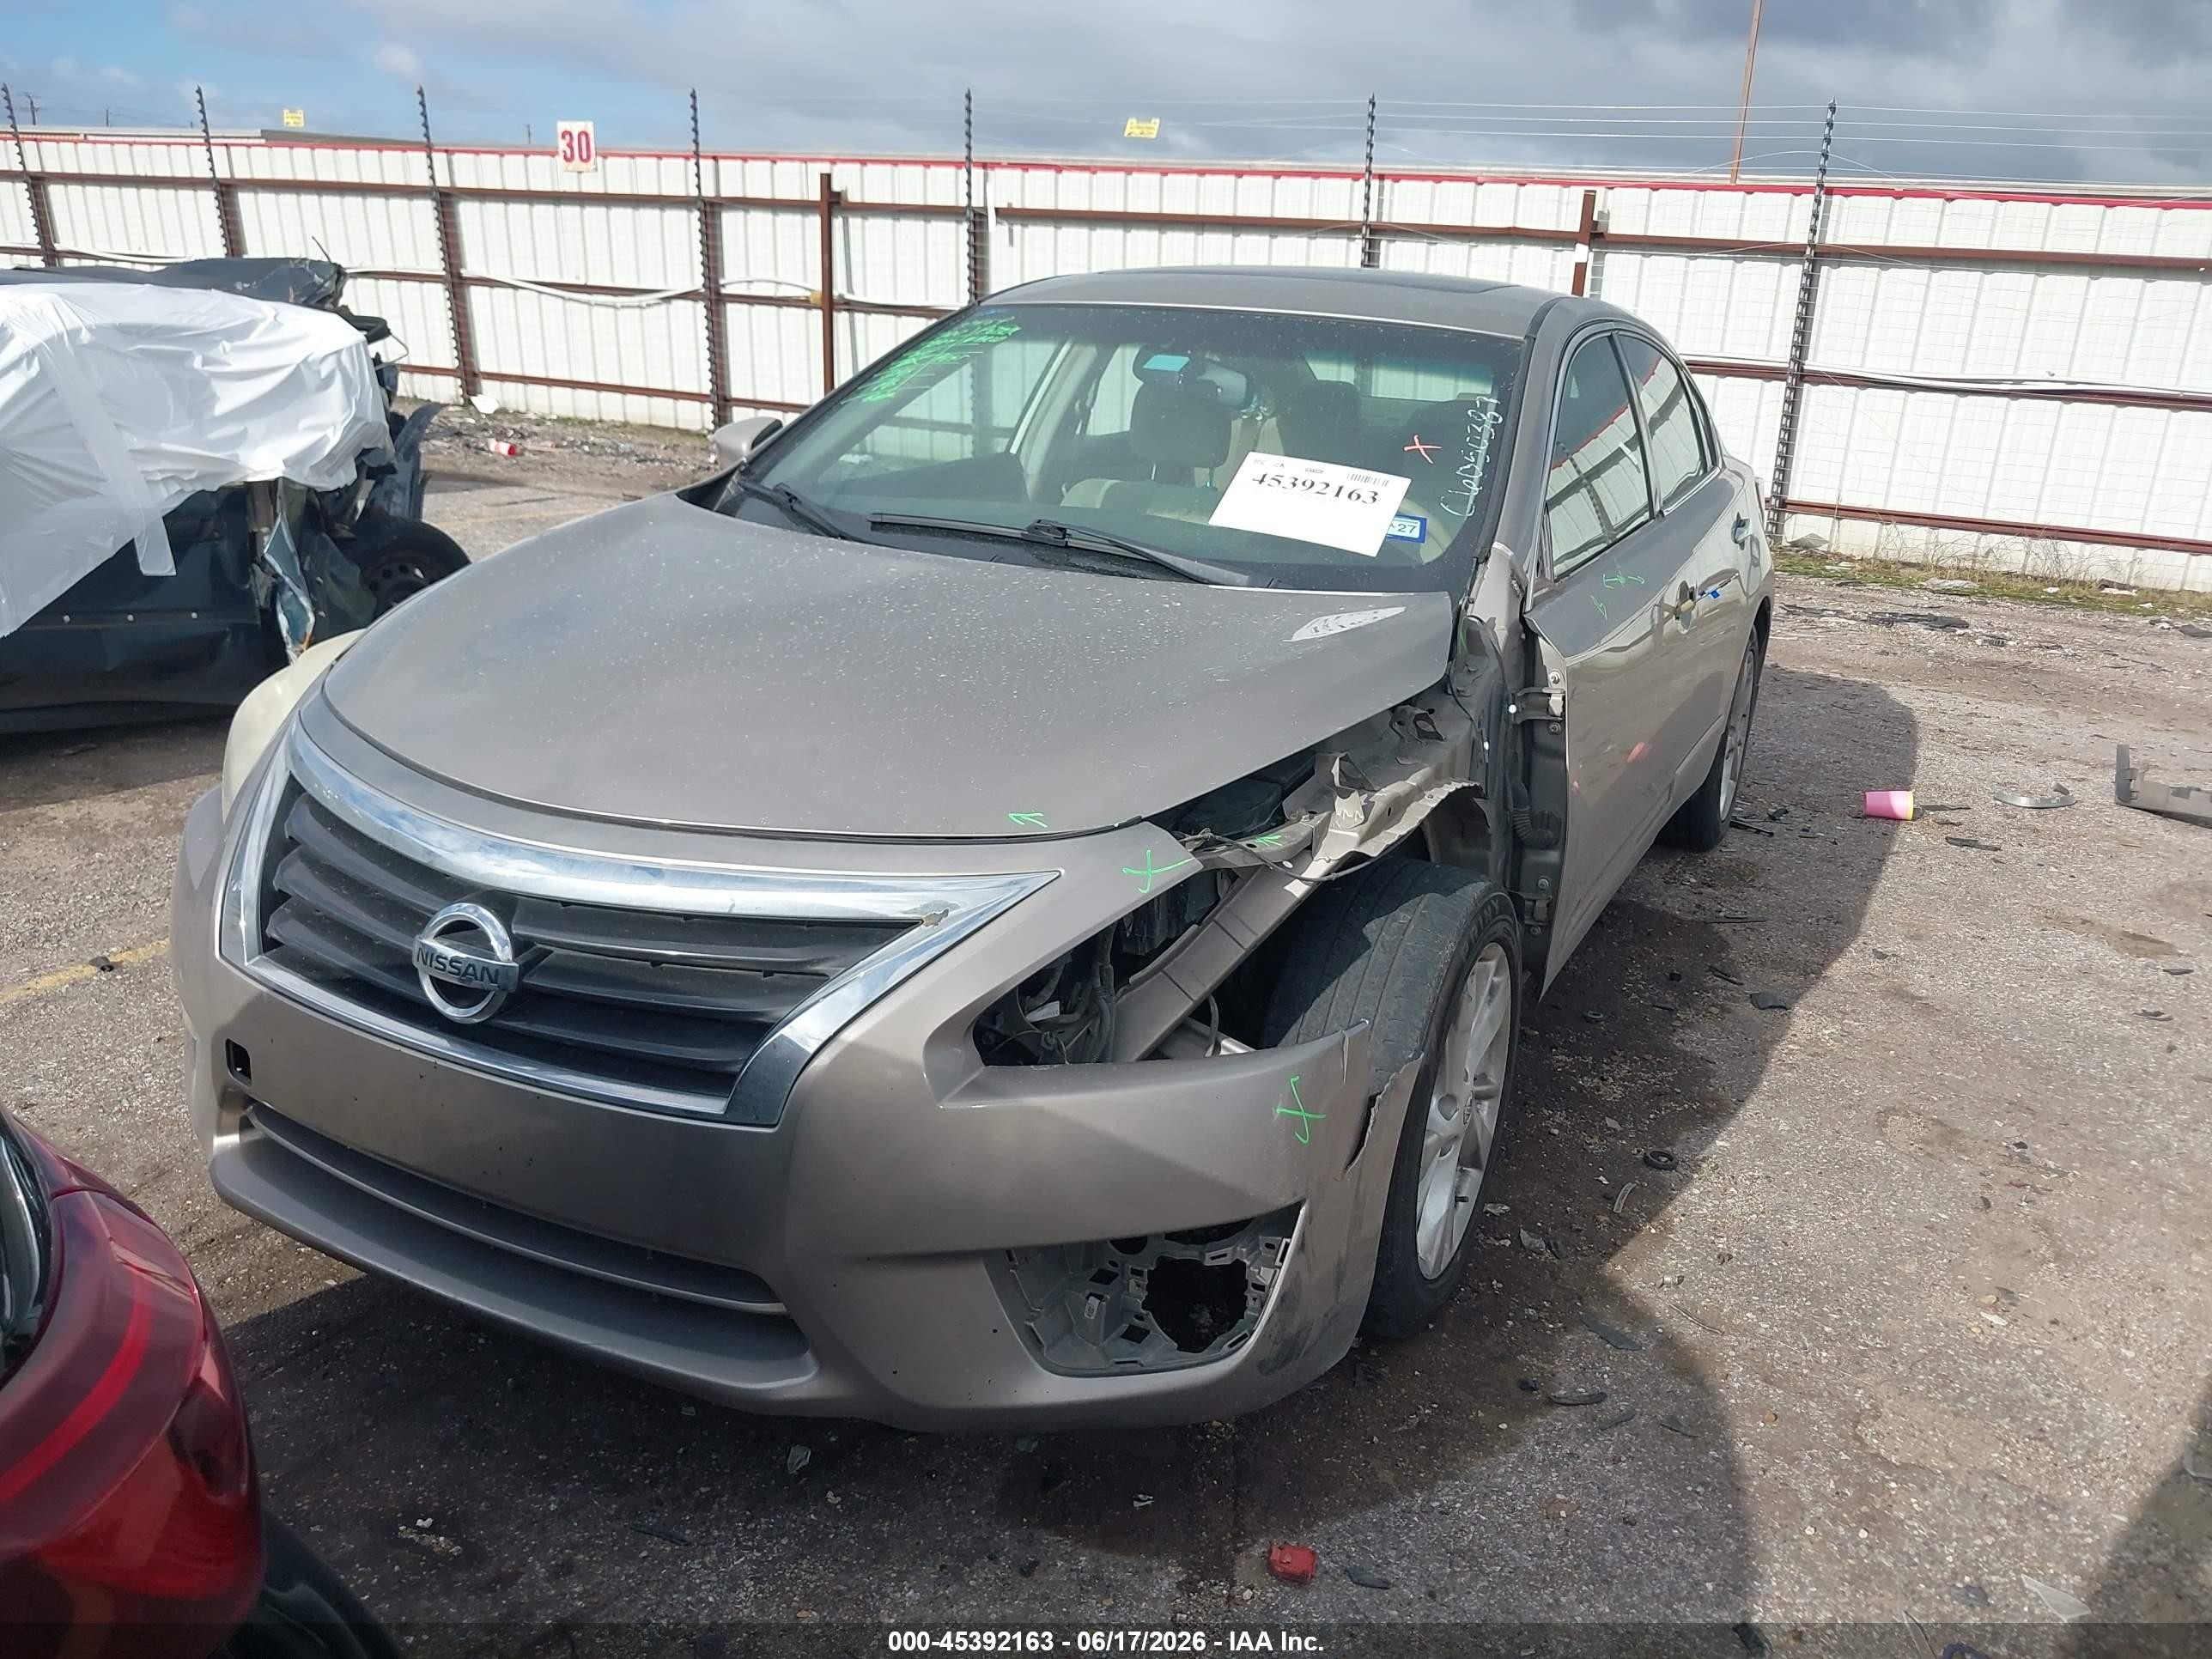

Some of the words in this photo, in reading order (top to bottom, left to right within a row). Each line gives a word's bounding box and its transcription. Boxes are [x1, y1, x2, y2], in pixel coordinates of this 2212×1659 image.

[561, 130, 591, 163] 30
[1252, 472, 1379, 505] 45392163
[1397, 523, 1418, 534] 27
[416, 947, 500, 985] NISSAN
